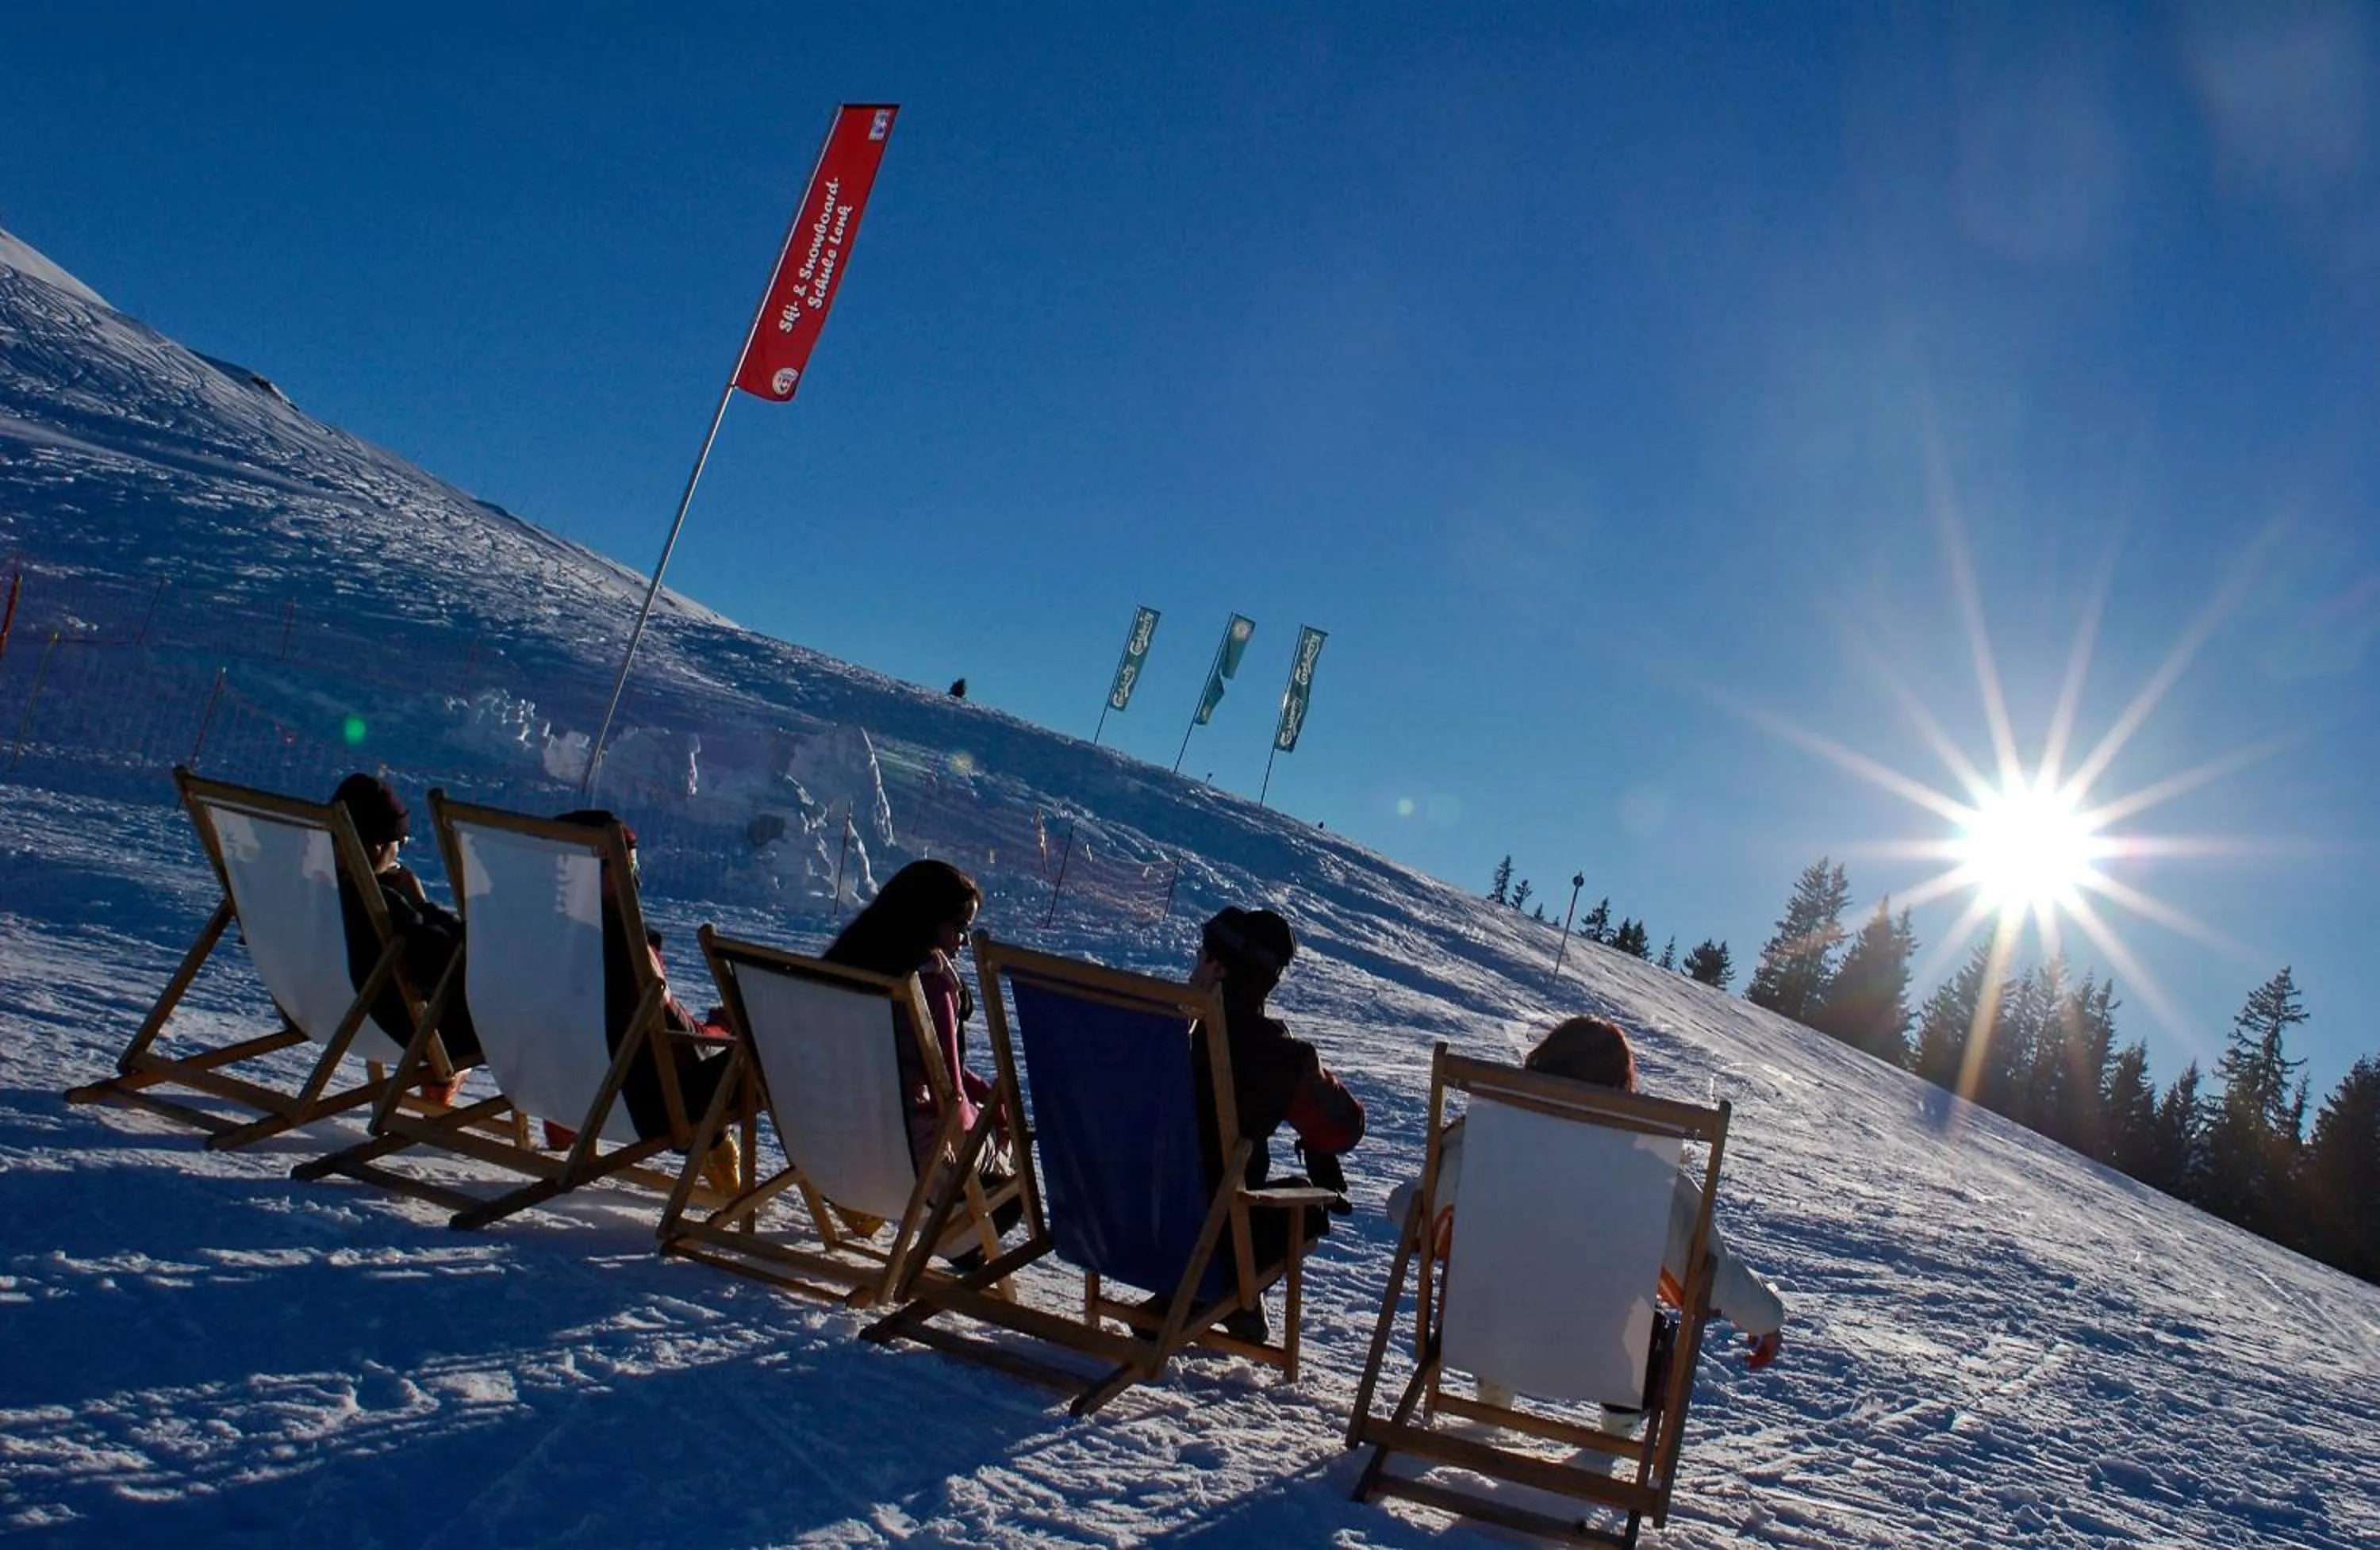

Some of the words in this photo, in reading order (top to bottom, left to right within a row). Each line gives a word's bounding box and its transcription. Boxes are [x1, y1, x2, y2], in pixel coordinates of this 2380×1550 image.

[779, 301, 800, 332] Ski-
[793, 284, 807, 297] &
[800, 177, 839, 280] Snowboard-
[808, 250, 837, 309] Schule
[829, 205, 854, 245] Lenk
